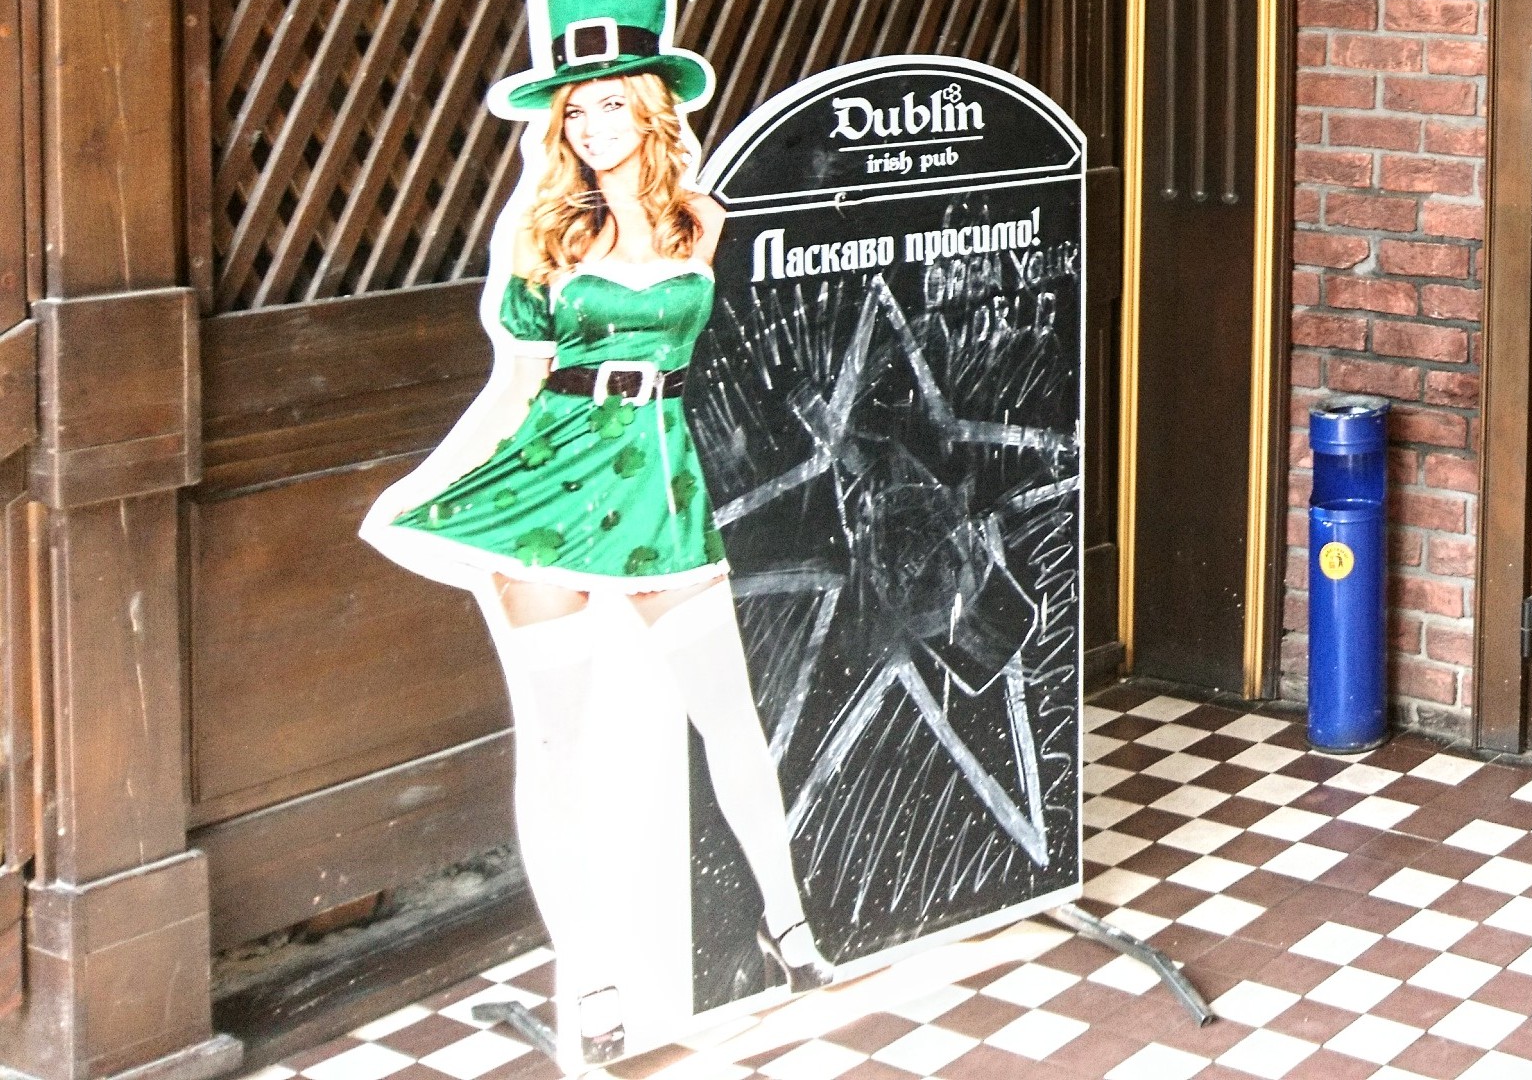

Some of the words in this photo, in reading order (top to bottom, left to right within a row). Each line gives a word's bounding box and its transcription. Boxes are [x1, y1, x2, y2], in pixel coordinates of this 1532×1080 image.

[828, 83, 986, 141] Dublin
[865, 149, 914, 175] irish
[919, 145, 960, 173] pub
[750, 227, 895, 283] Ласкаво
[904, 206, 1042, 266] просимо!
